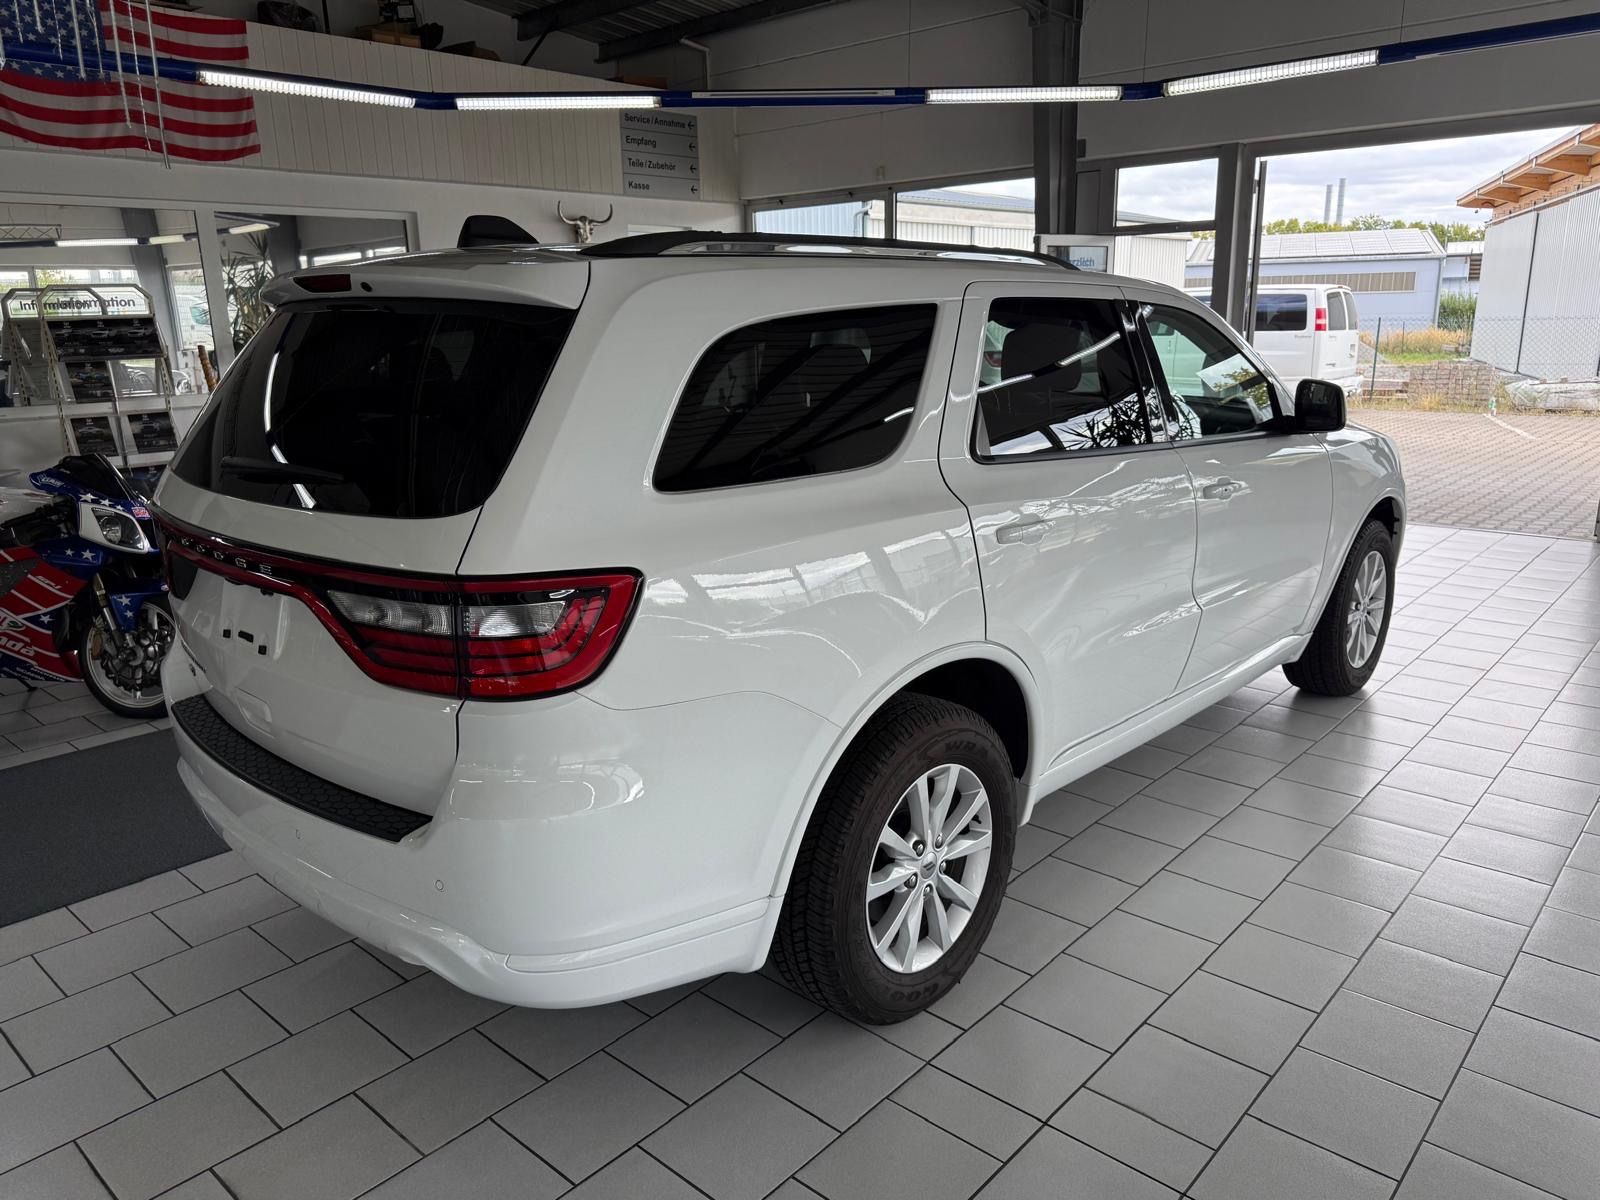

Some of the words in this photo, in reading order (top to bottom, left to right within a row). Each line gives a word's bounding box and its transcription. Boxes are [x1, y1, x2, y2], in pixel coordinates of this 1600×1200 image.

[625, 135, 657, 148] Empfang
[628, 181, 650, 190] Kasse
[19, 299, 90, 311] Infrmation
[57, 296, 136, 310] Information
